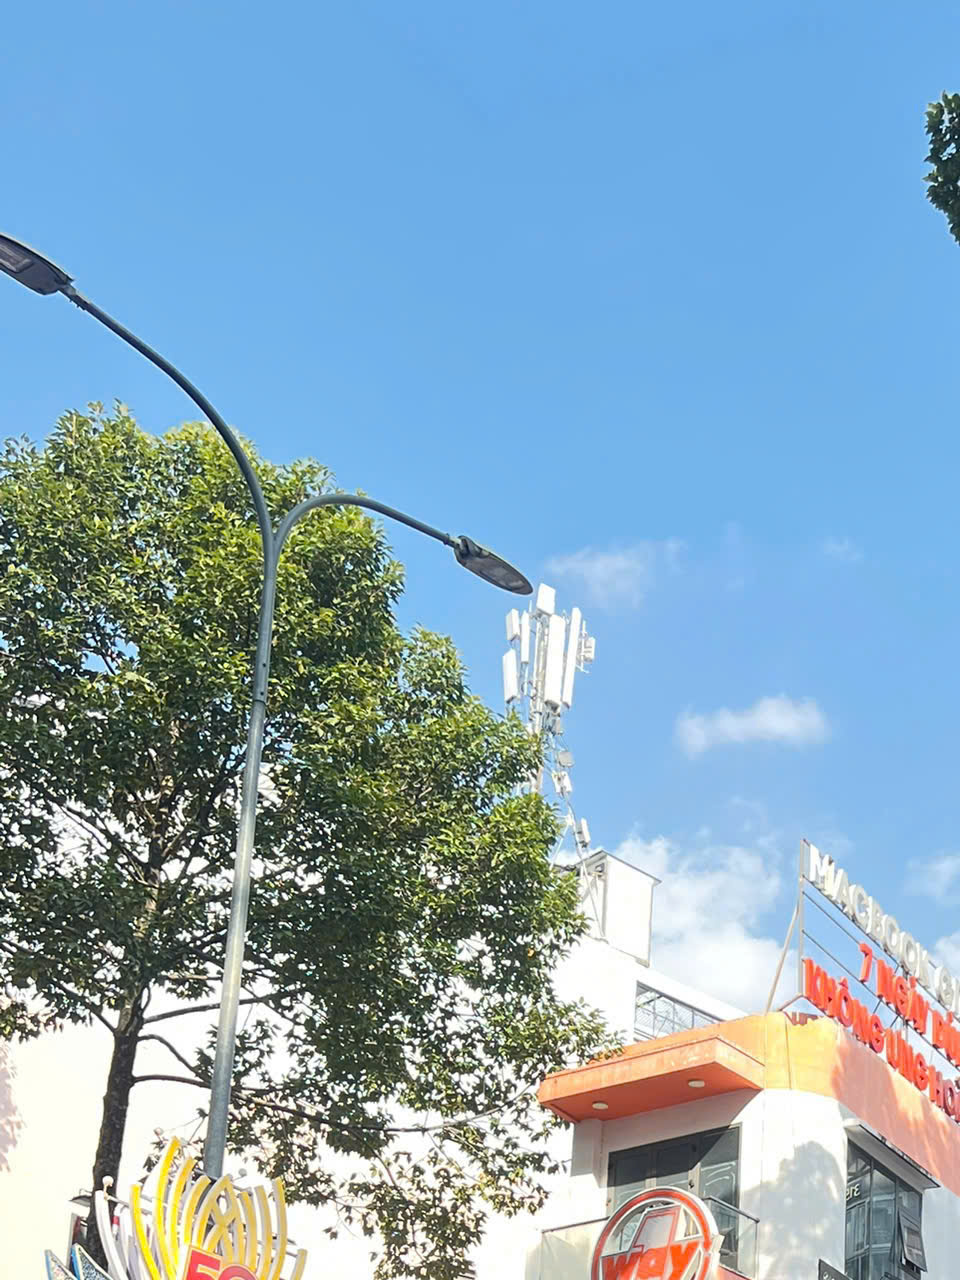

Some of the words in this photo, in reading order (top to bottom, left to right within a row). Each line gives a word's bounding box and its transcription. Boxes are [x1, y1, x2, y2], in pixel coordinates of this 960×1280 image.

[809, 843, 930, 991] MACBOOK
[859, 943, 873, 984] 7
[804, 958, 884, 1054] KHÔNG
